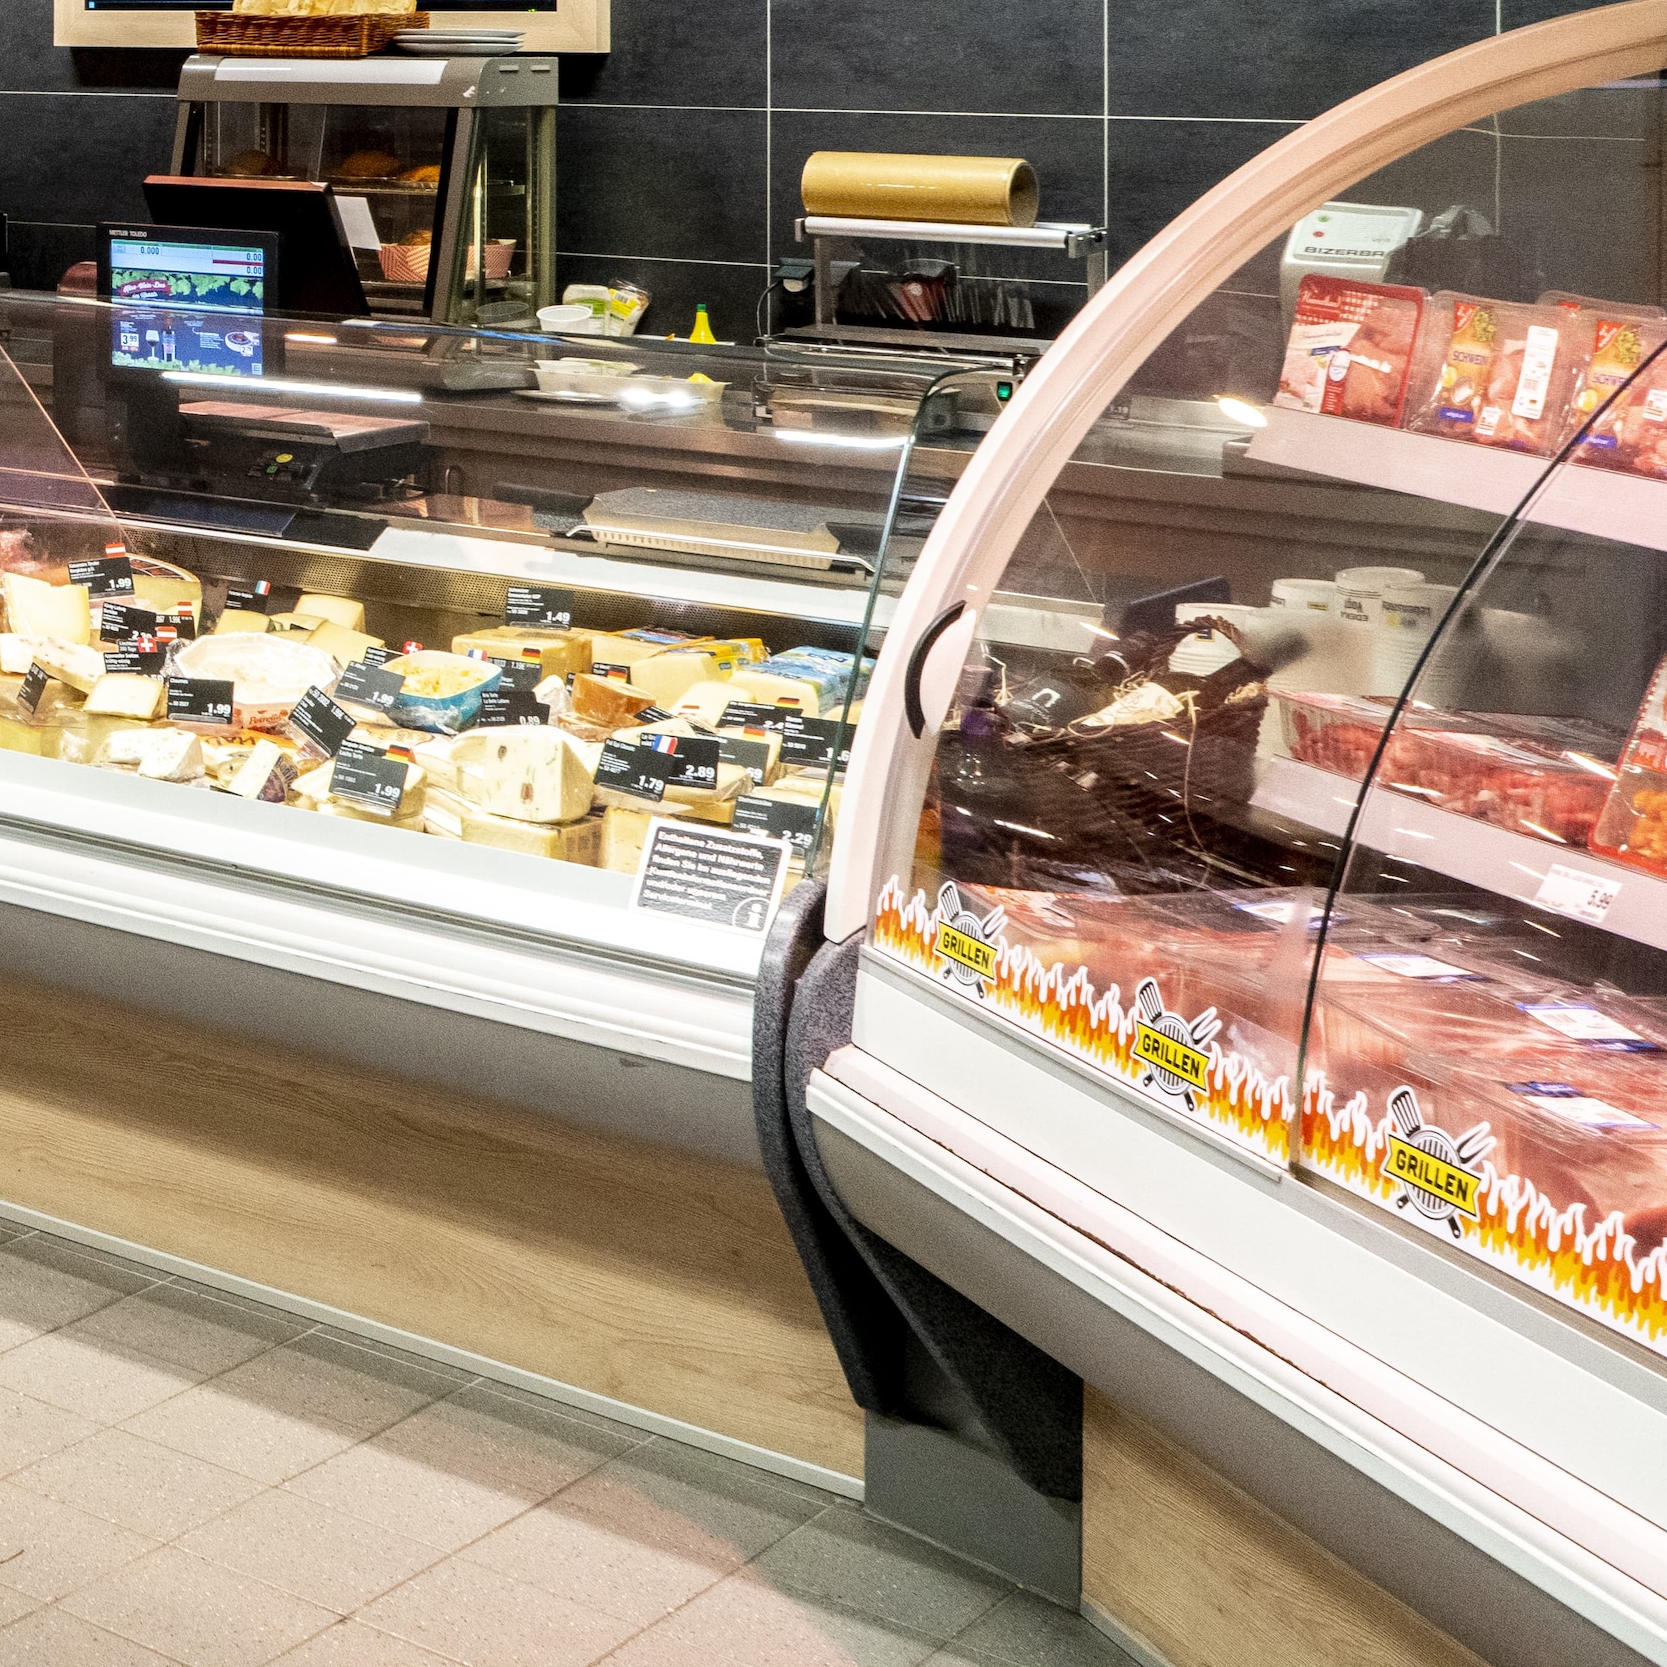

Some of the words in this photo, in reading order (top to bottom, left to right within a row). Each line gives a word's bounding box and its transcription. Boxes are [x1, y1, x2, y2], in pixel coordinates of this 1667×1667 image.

[246, 253, 262, 262] 0.00
[246, 266, 262, 275] 0.00
[109, 578, 132, 589] 1.99
[546, 611, 571, 623] 1.49
[372, 691, 394, 705] 1.99
[207, 703, 231, 715] 1.99
[685, 765, 715, 779] 2.89
[639, 775, 665, 791] 1.79
[374, 783, 400, 798] 1.99
[782, 830, 813, 846] 2.29
[698, 850, 716, 862] und
[943, 932, 990, 969] GRILLEN
[1142, 1033, 1200, 1079] GRILLEN
[1396, 1149, 1468, 1202] GRILLEN
